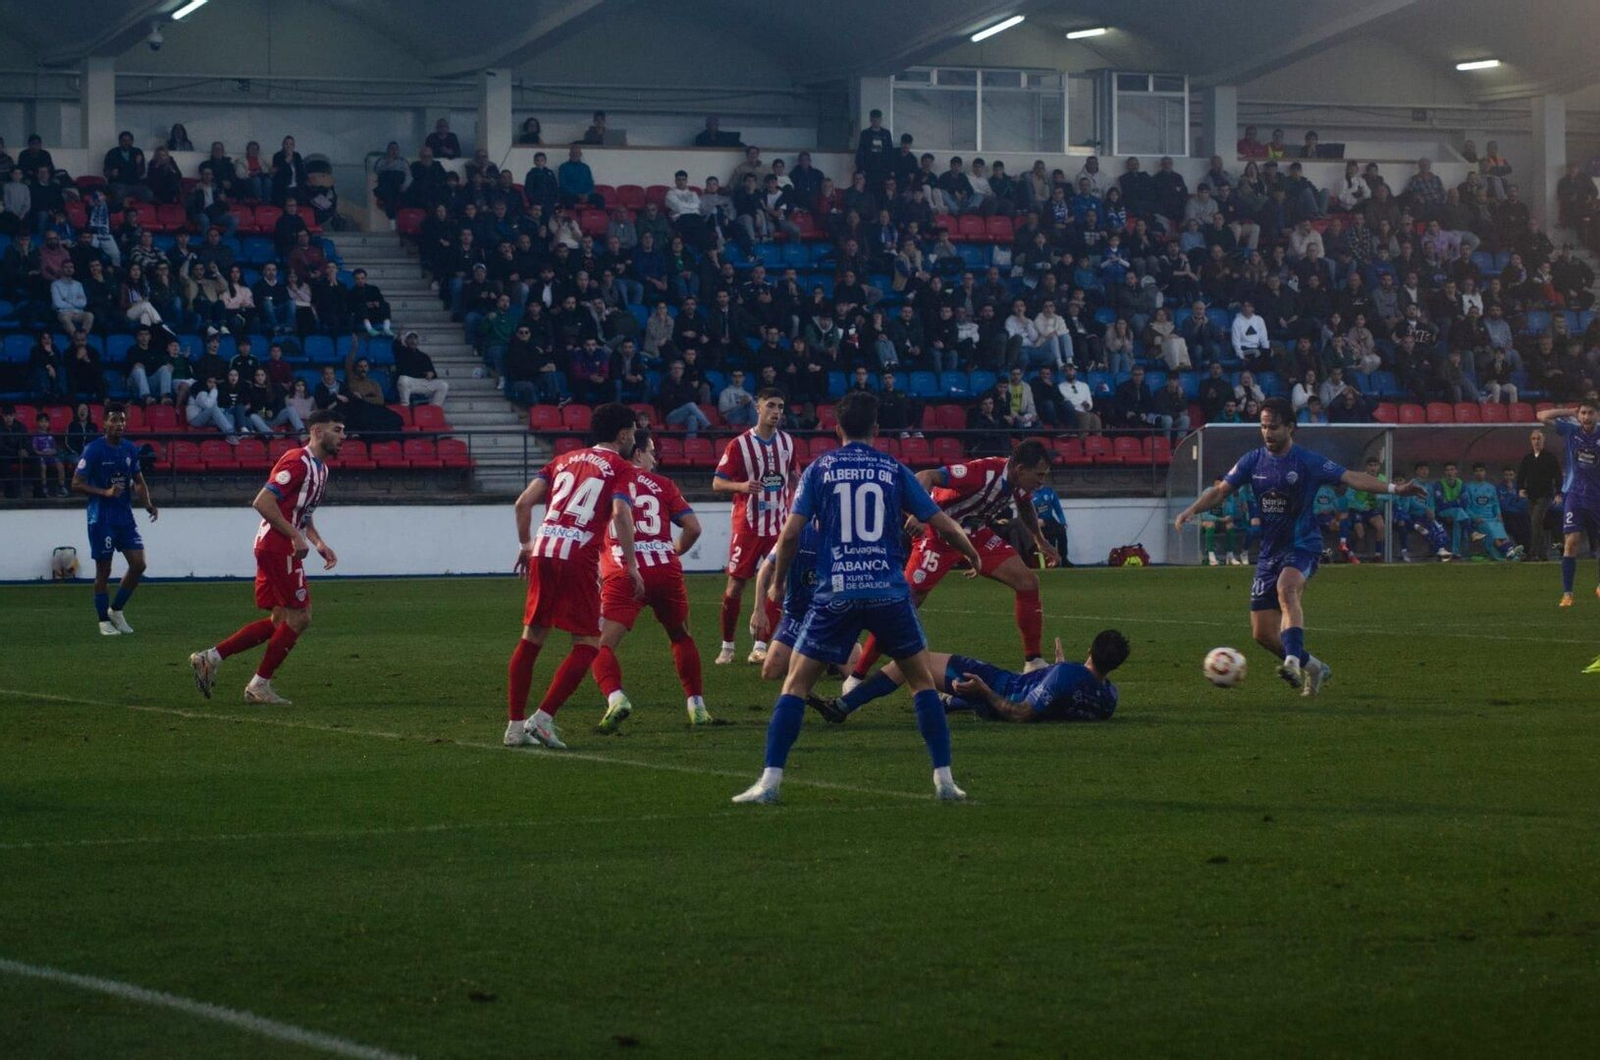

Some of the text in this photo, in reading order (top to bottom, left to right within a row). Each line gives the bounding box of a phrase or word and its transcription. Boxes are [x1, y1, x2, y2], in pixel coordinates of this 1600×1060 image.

[637, 475, 662, 494] GUEZ
[823, 468, 894, 485] ALBERTO GIL
[544, 471, 605, 527] 24
[833, 482, 885, 543] 10
[1566, 511, 1573, 524] 2
[544, 527, 580, 540] BANCA
[731, 546, 742, 563] 2
[921, 549, 940, 573] 15
[836, 560, 890, 572] ABANCA
[847, 574, 874, 582] XUNTA
